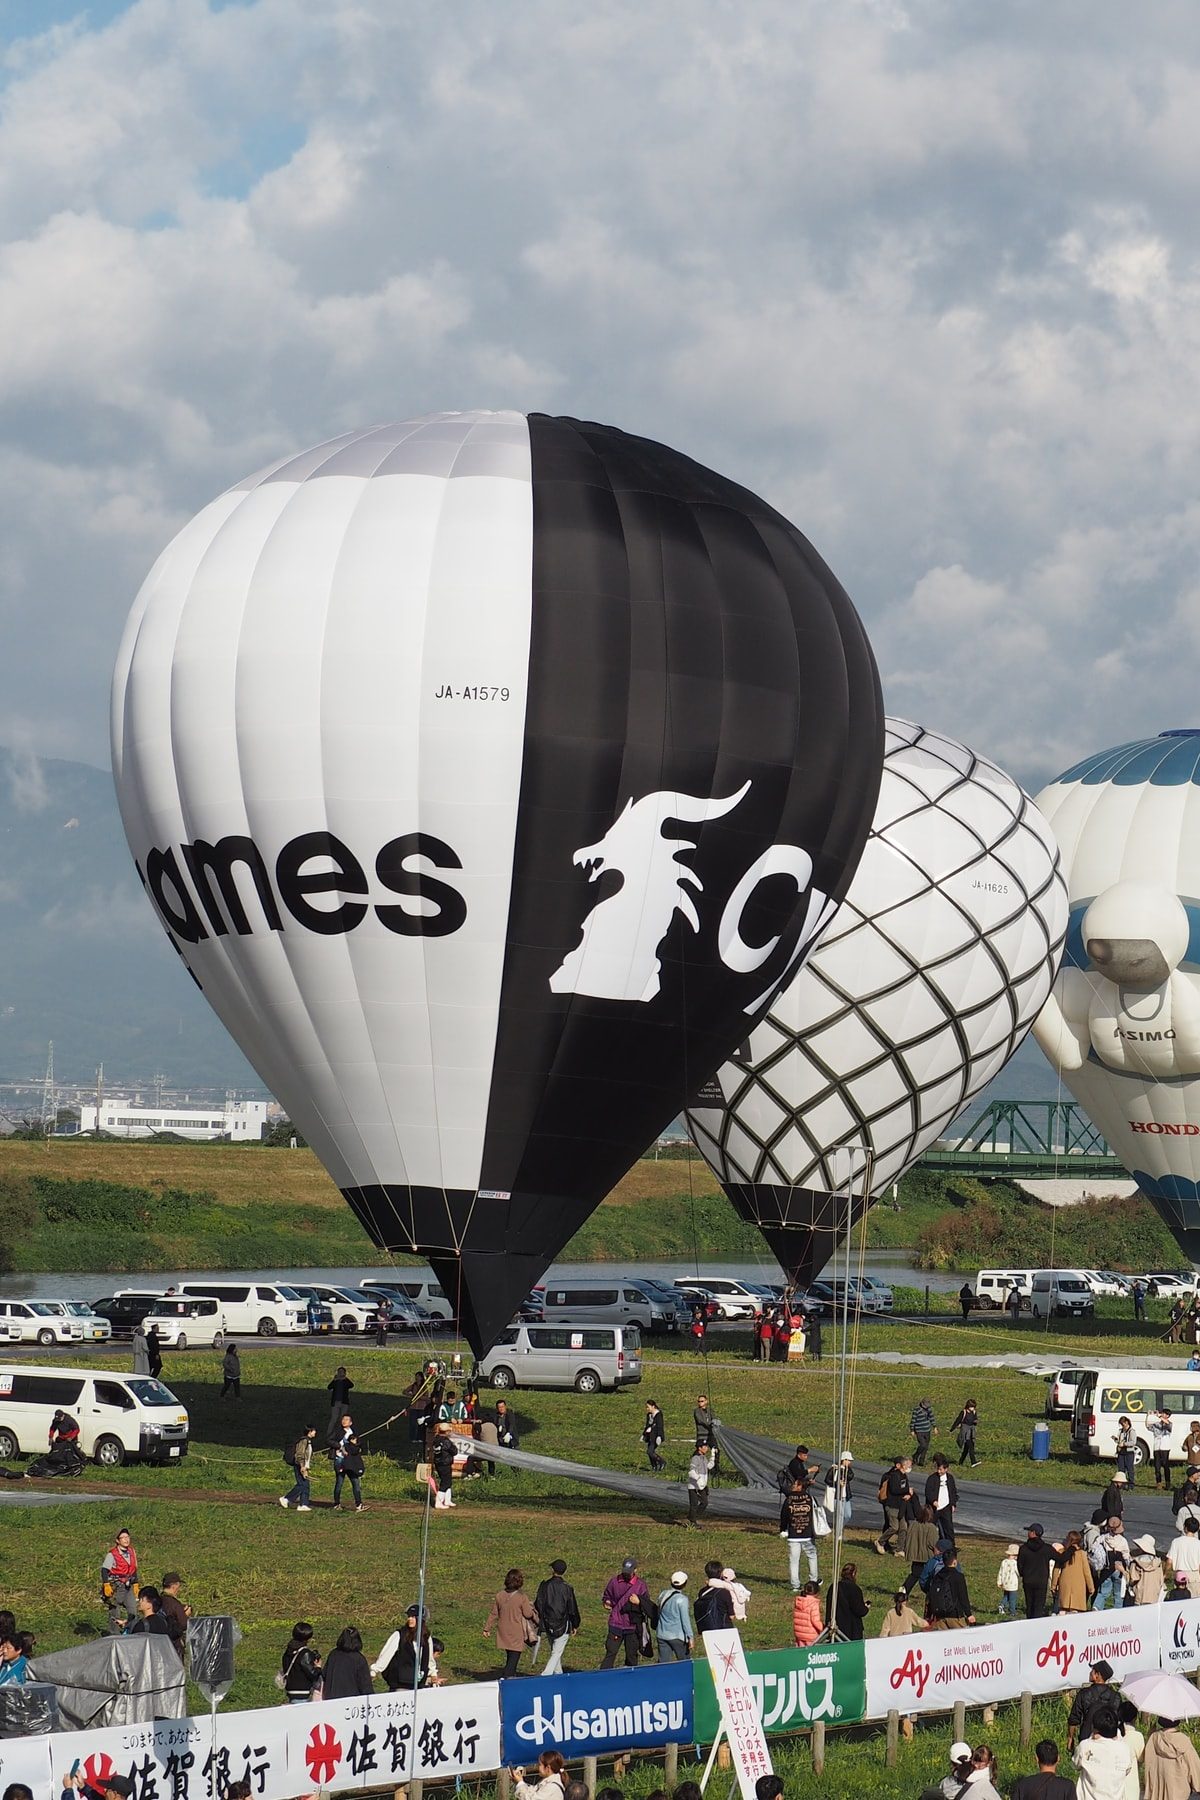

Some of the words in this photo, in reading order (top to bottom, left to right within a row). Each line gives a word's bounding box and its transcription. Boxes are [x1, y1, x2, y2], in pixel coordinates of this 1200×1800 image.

[435, 685, 510, 701] JA-A1579
[136, 831, 468, 986] ames
[1114, 1027, 1176, 1041] ASIMO
[1106, 1388, 1143, 1412] 96
[1079, 1638, 1141, 1664] AJINOMOTO
[935, 1658, 1003, 1685] AJINOMOTO
[515, 1694, 684, 1745] Hisamitsu
[346, 1717, 481, 1776] 佐賀銀行
[127, 1744, 268, 1800] 佐賀銀行
